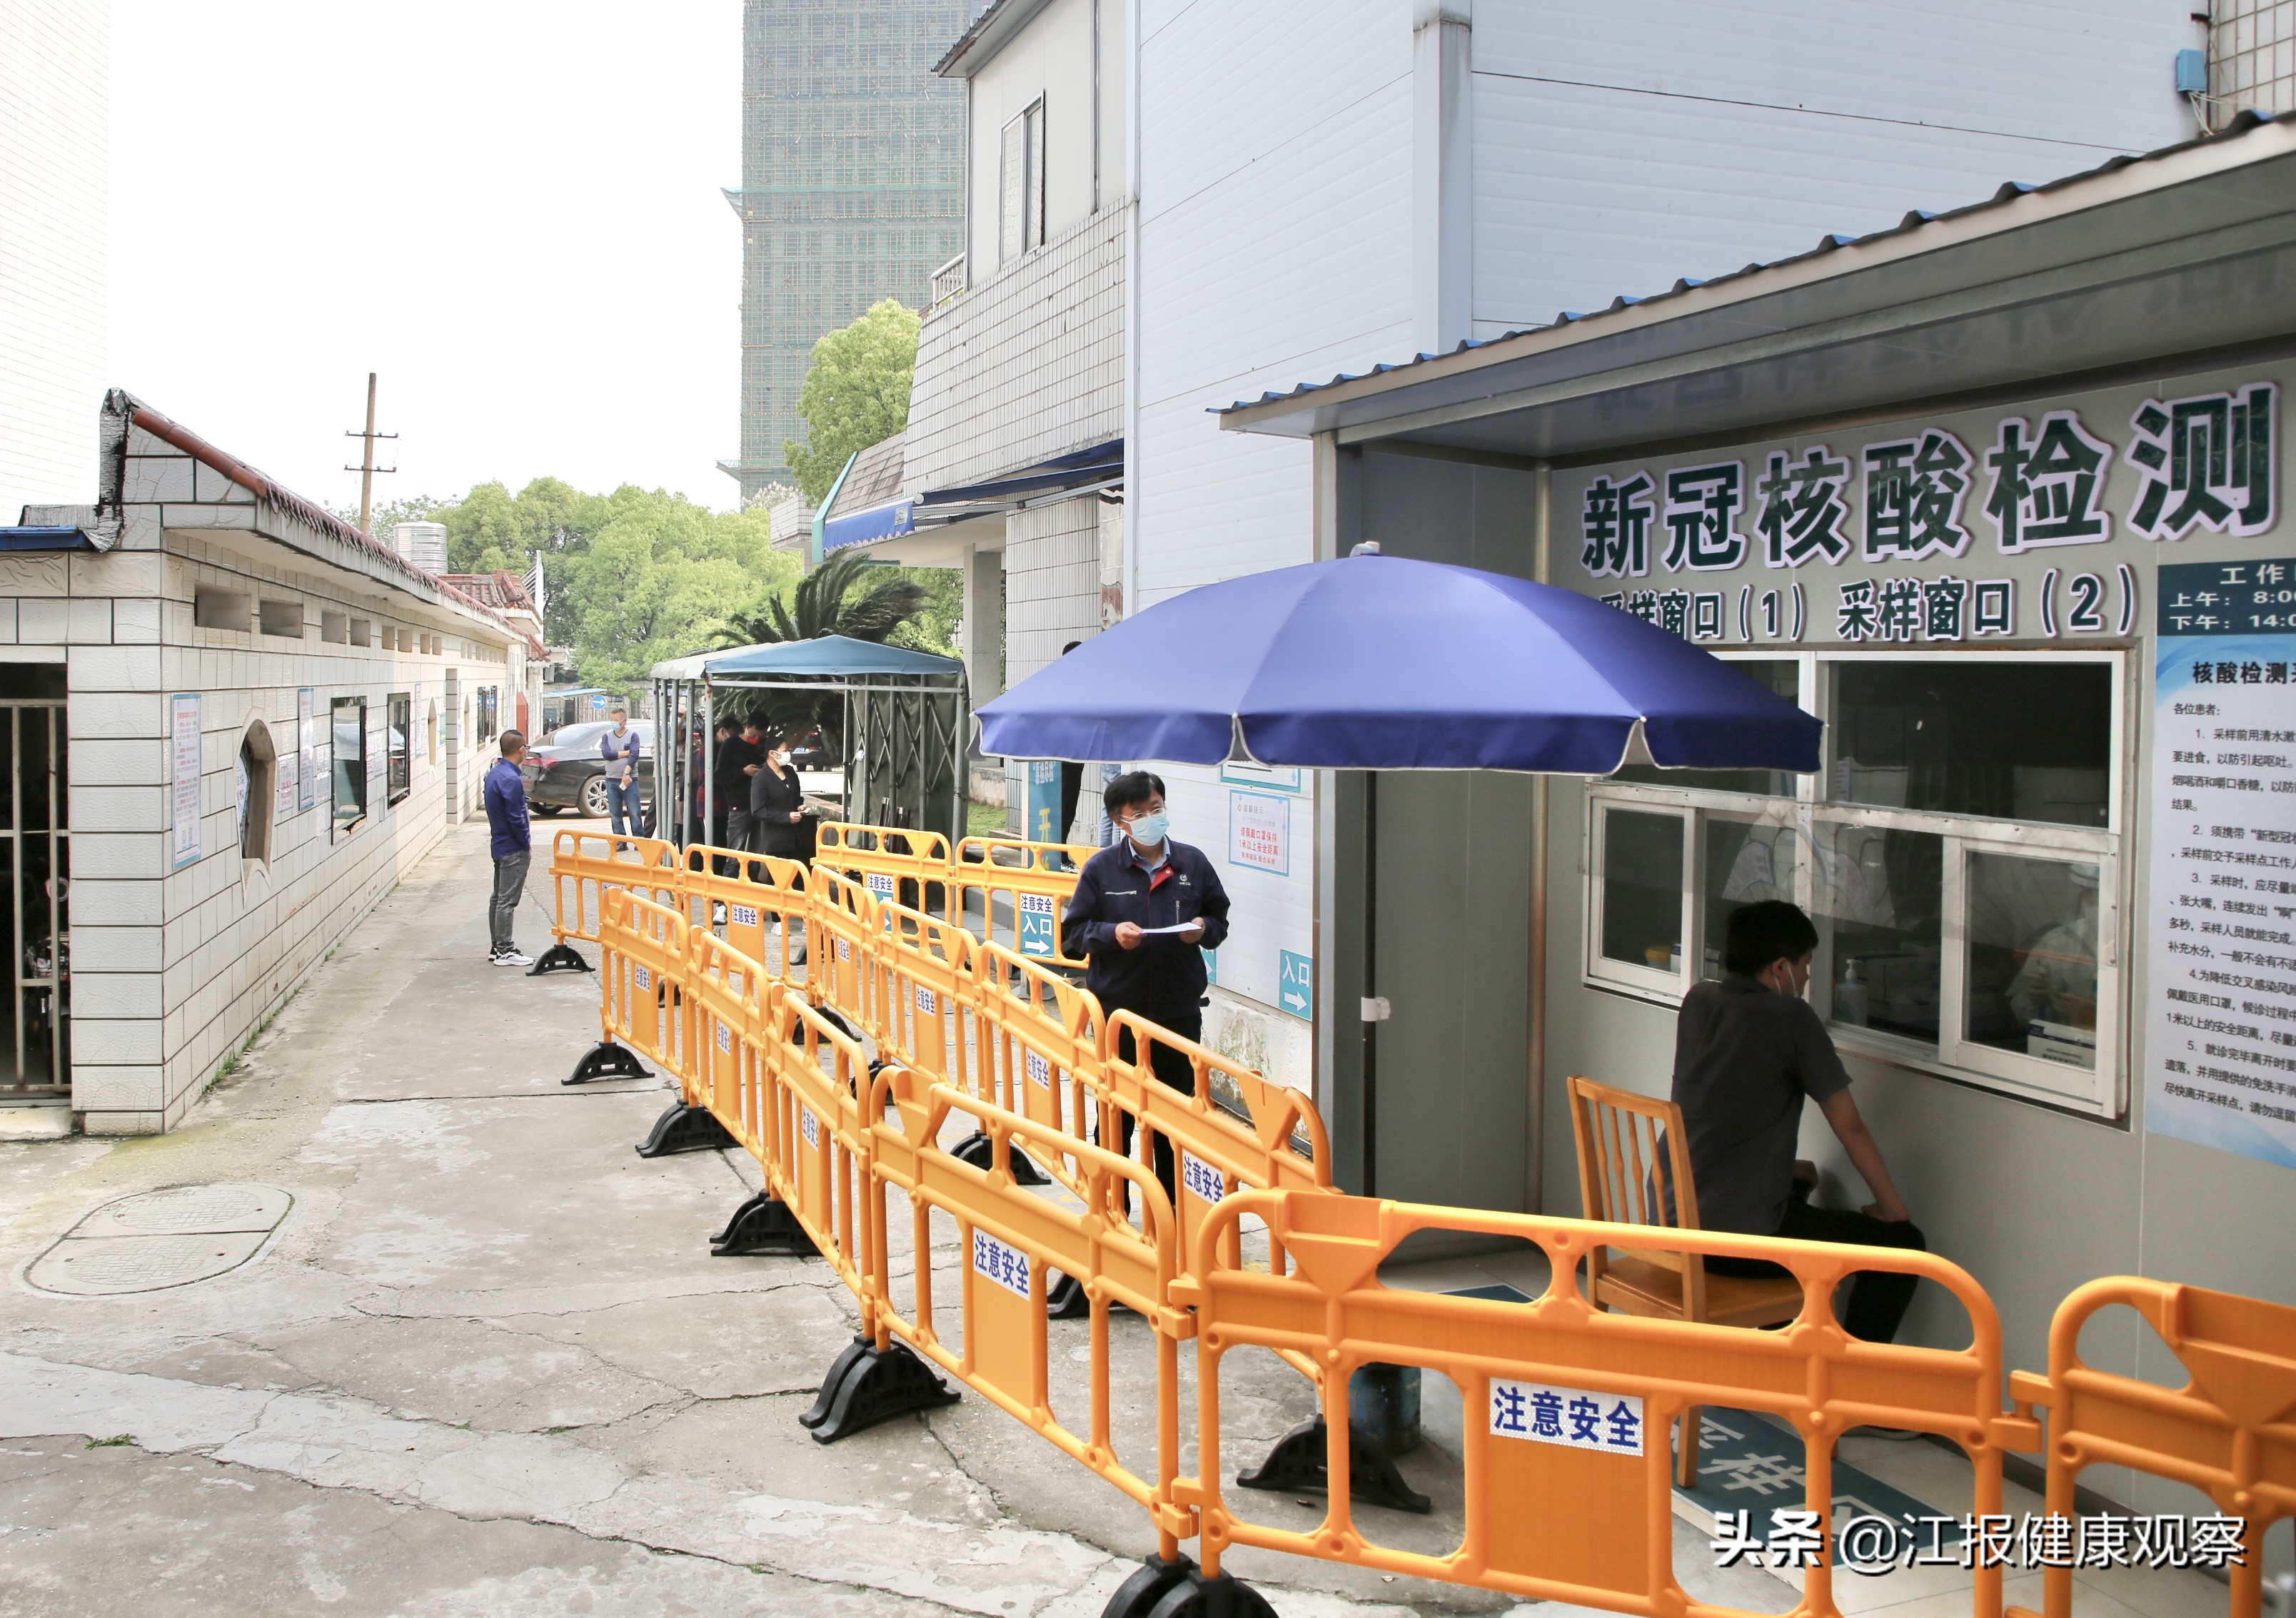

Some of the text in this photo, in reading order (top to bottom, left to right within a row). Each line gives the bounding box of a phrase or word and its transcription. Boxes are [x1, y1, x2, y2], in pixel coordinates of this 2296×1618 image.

[1580, 383, 2277, 577] 新冠核酸检测
[2220, 564, 2296, 585] 工作
[1837, 565, 2135, 641] 采样窗口（2）
[2253, 590, 2296, 604] 8:0
[2172, 774, 2296, 794] 烟喝酒和嚼口香糖，以防
[868, 875, 892, 891] 注意安全
[732, 906, 756, 924] 注意安全
[1021, 895, 1052, 913] 注意安全
[1022, 914, 1052, 936] 入口
[1282, 955, 1310, 987] 入口
[916, 987, 935, 1013] 注意安全
[2167, 1013, 2296, 1046] 1米以上的安全距离，尽量
[1027, 1051, 1049, 1087] 注意安全
[1184, 1155, 1224, 1203] 注意安全
[975, 1234, 1029, 1295] 注意安全
[1493, 1386, 1640, 1449] 注意安全
